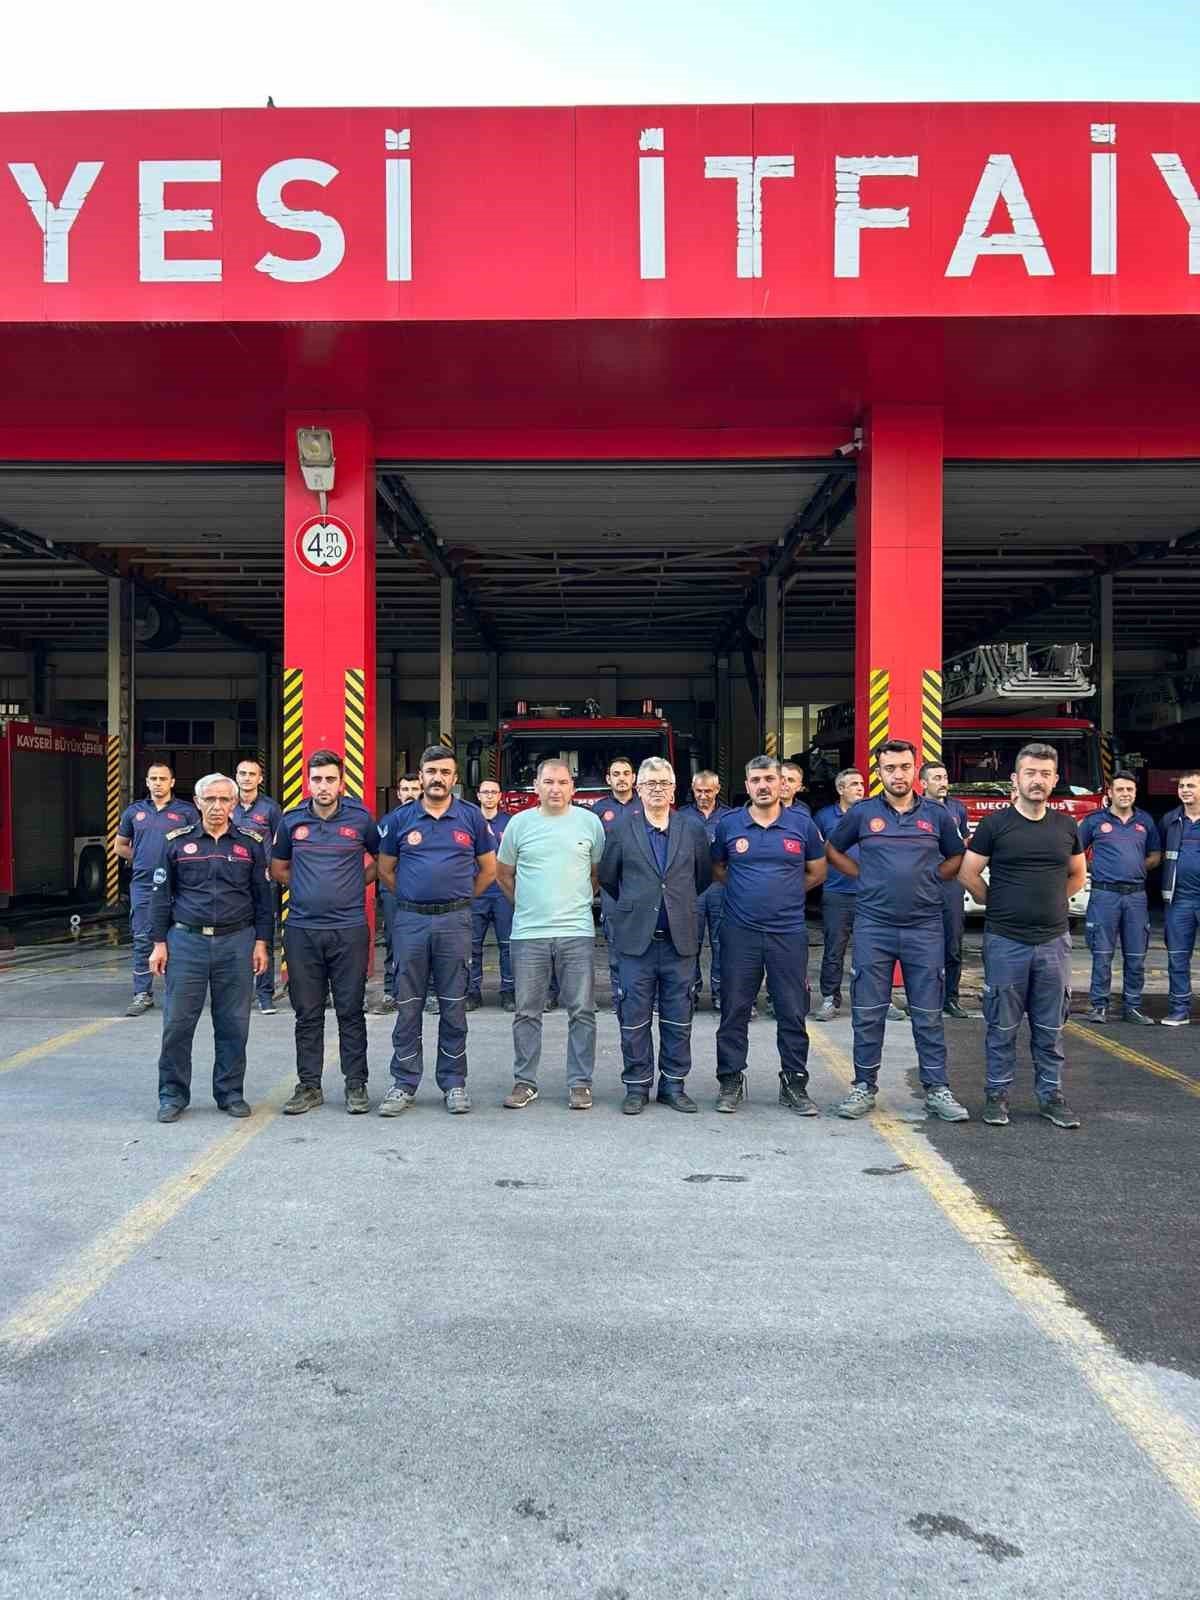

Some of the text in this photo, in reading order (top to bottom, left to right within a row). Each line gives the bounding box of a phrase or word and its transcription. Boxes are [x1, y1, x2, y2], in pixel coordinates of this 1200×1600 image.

[8, 128, 412, 283] YESİ
[17, 734, 52, 750] KAYSERİ
[976, 801, 1010, 809] IVECO
